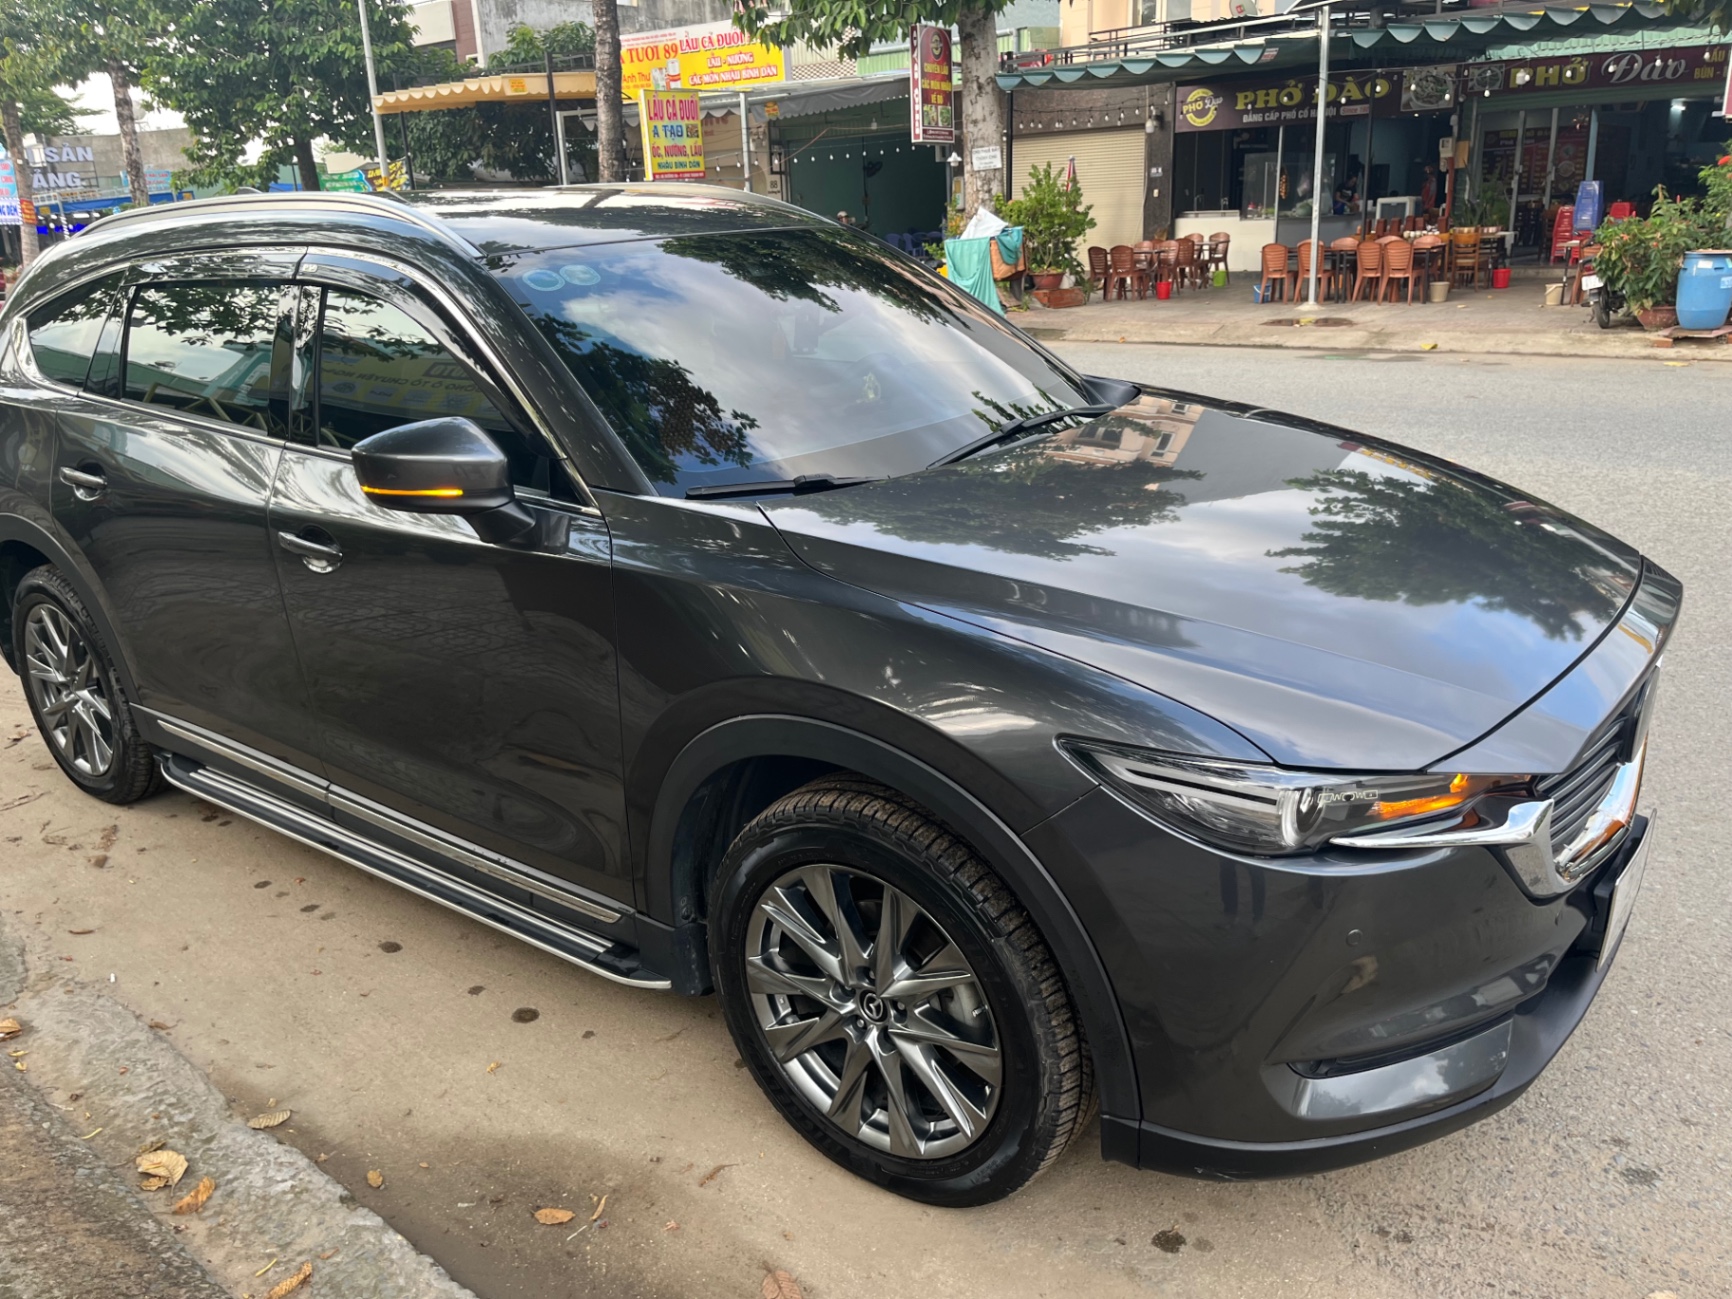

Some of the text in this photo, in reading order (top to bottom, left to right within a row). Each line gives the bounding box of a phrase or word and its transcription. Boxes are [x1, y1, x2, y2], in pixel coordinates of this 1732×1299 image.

[664, 43, 678, 59] 89
[1509, 57, 1589, 88] PHỞ
[1235, 79, 1303, 110] PHỞ
[1311, 76, 1392, 103] ĐÀO
[45, 142, 94, 162] SẢN
[32, 168, 81, 188] ẢNG
